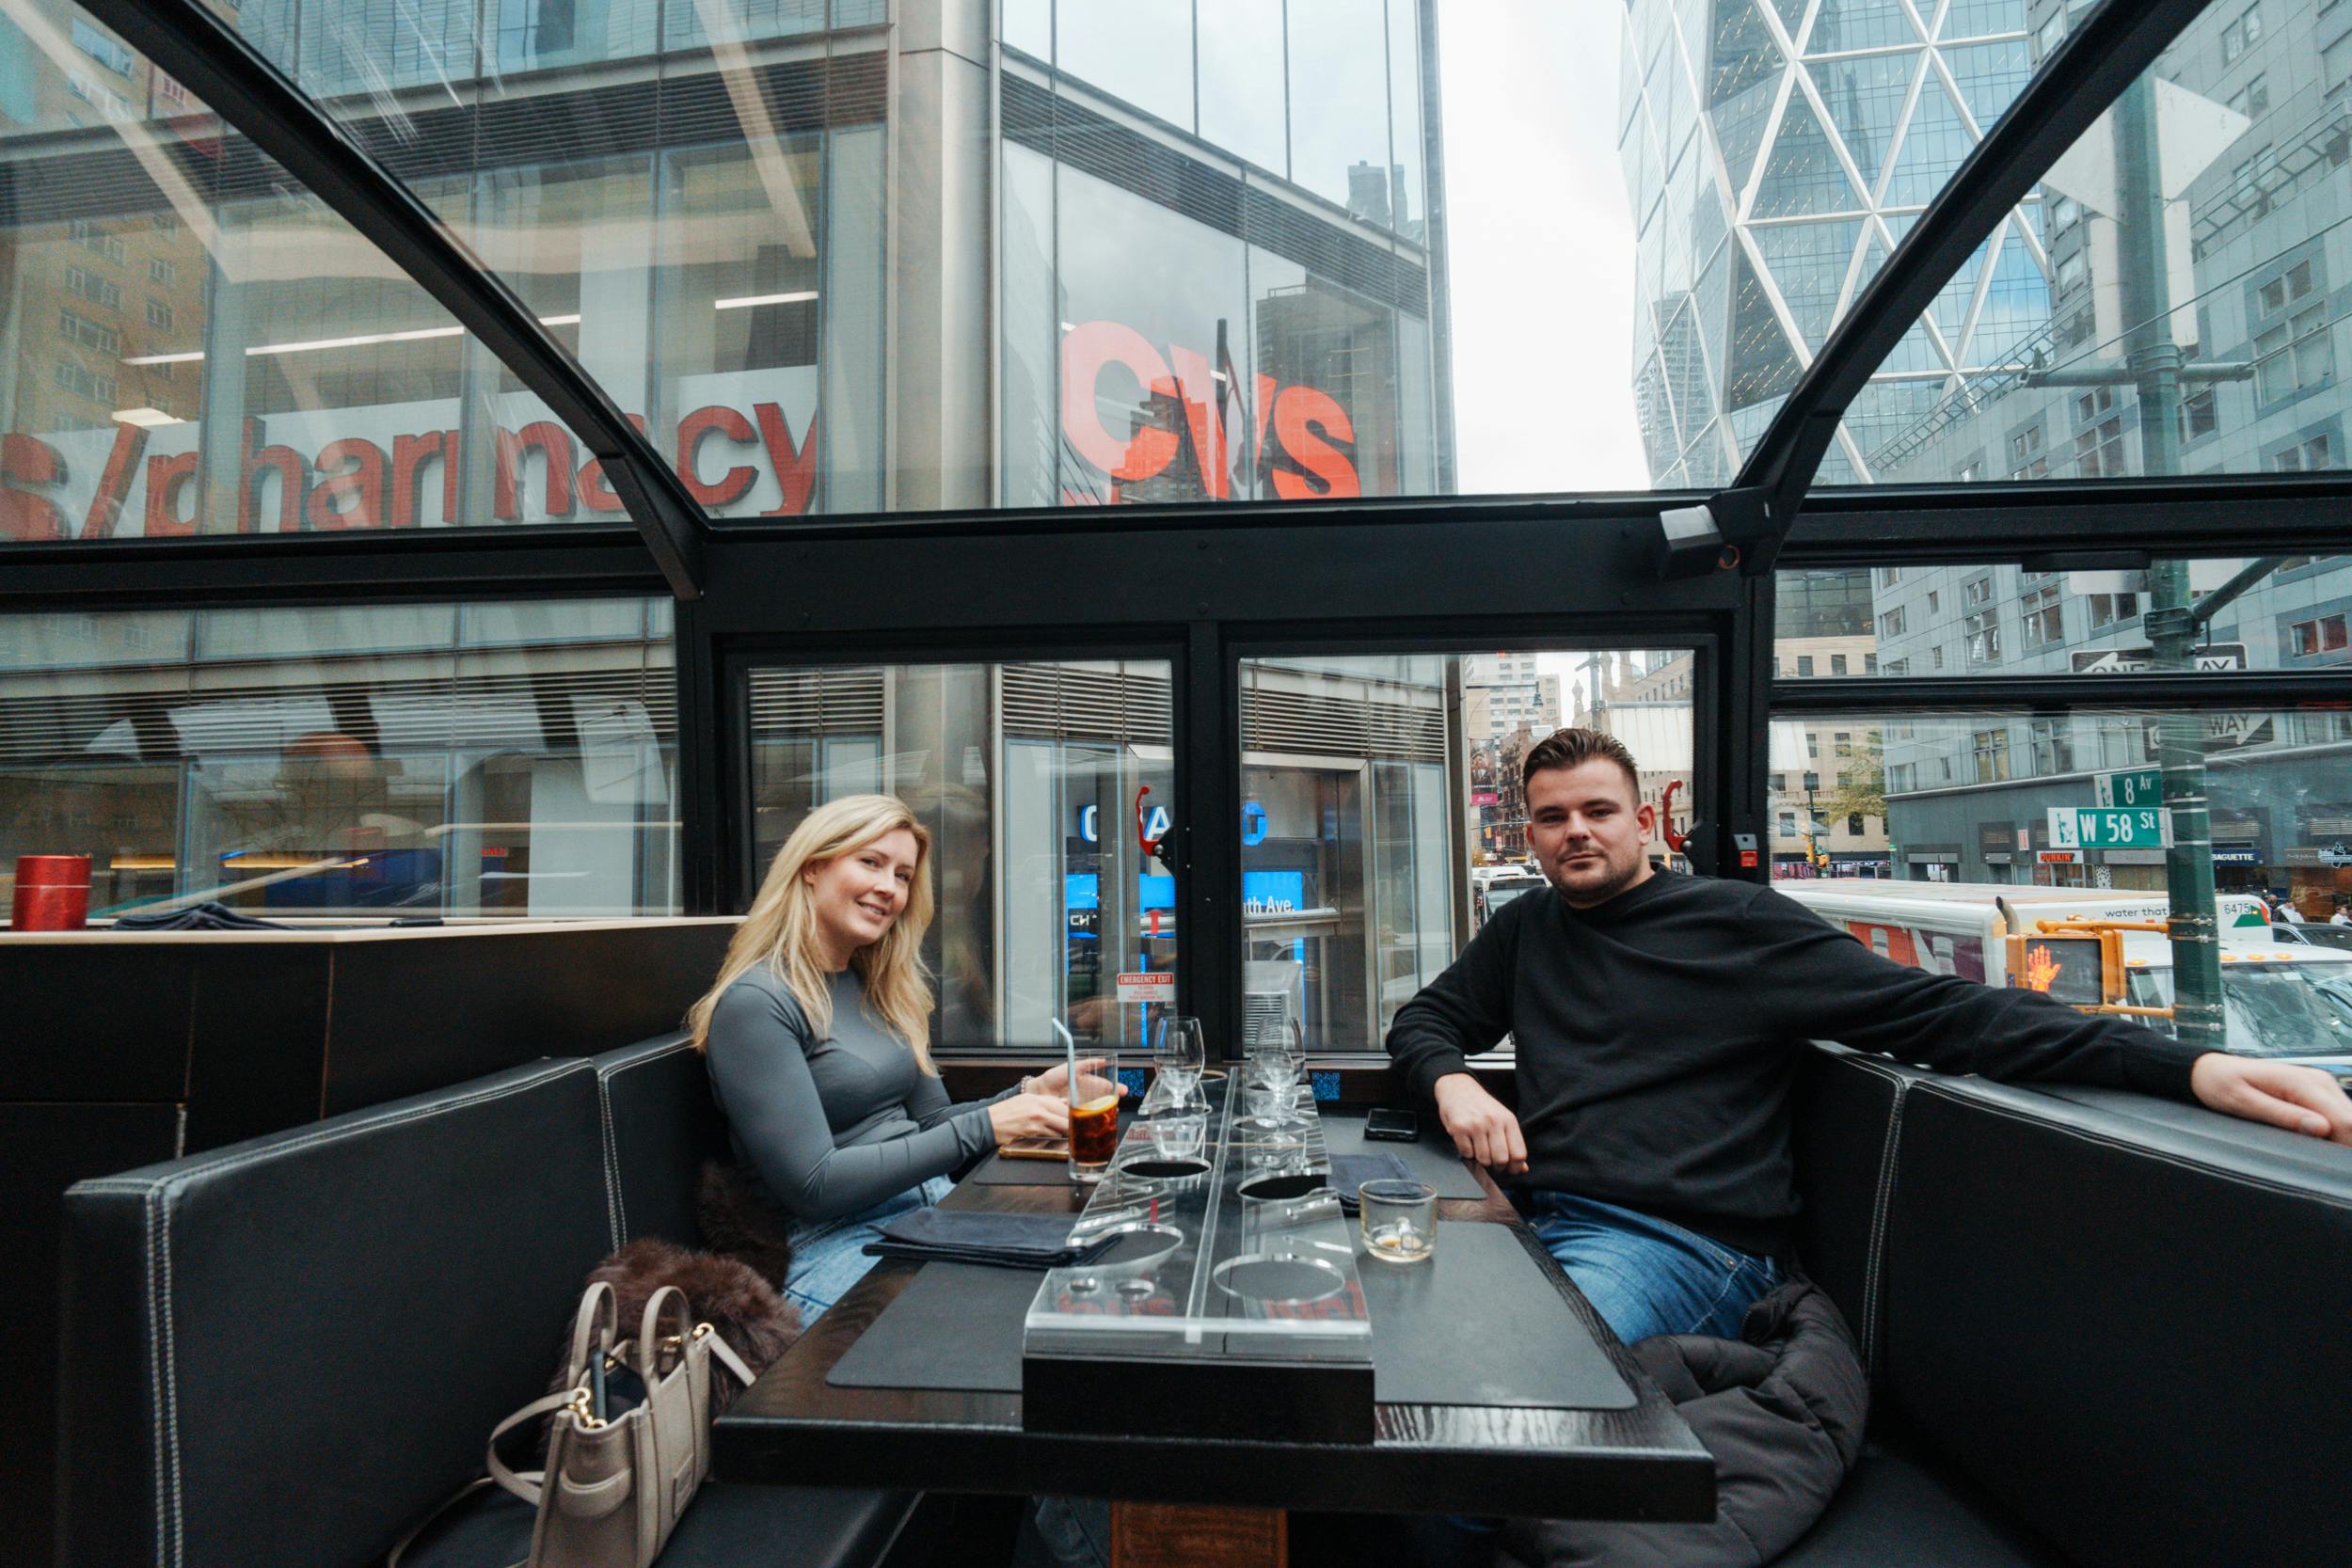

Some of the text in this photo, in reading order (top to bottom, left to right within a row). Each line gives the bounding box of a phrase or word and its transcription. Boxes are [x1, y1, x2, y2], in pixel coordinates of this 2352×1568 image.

[1061, 321, 1361, 500] CVS
[2124, 775, 2152, 804] 8 Av
[2079, 812, 2155, 843] W 58 St
[1266, 895, 1295, 913] Ave.
[2105, 907, 2168, 918] water that
[2224, 903, 2250, 914] 6475
[1120, 974, 1172, 984] EMERGENCY EXIT
